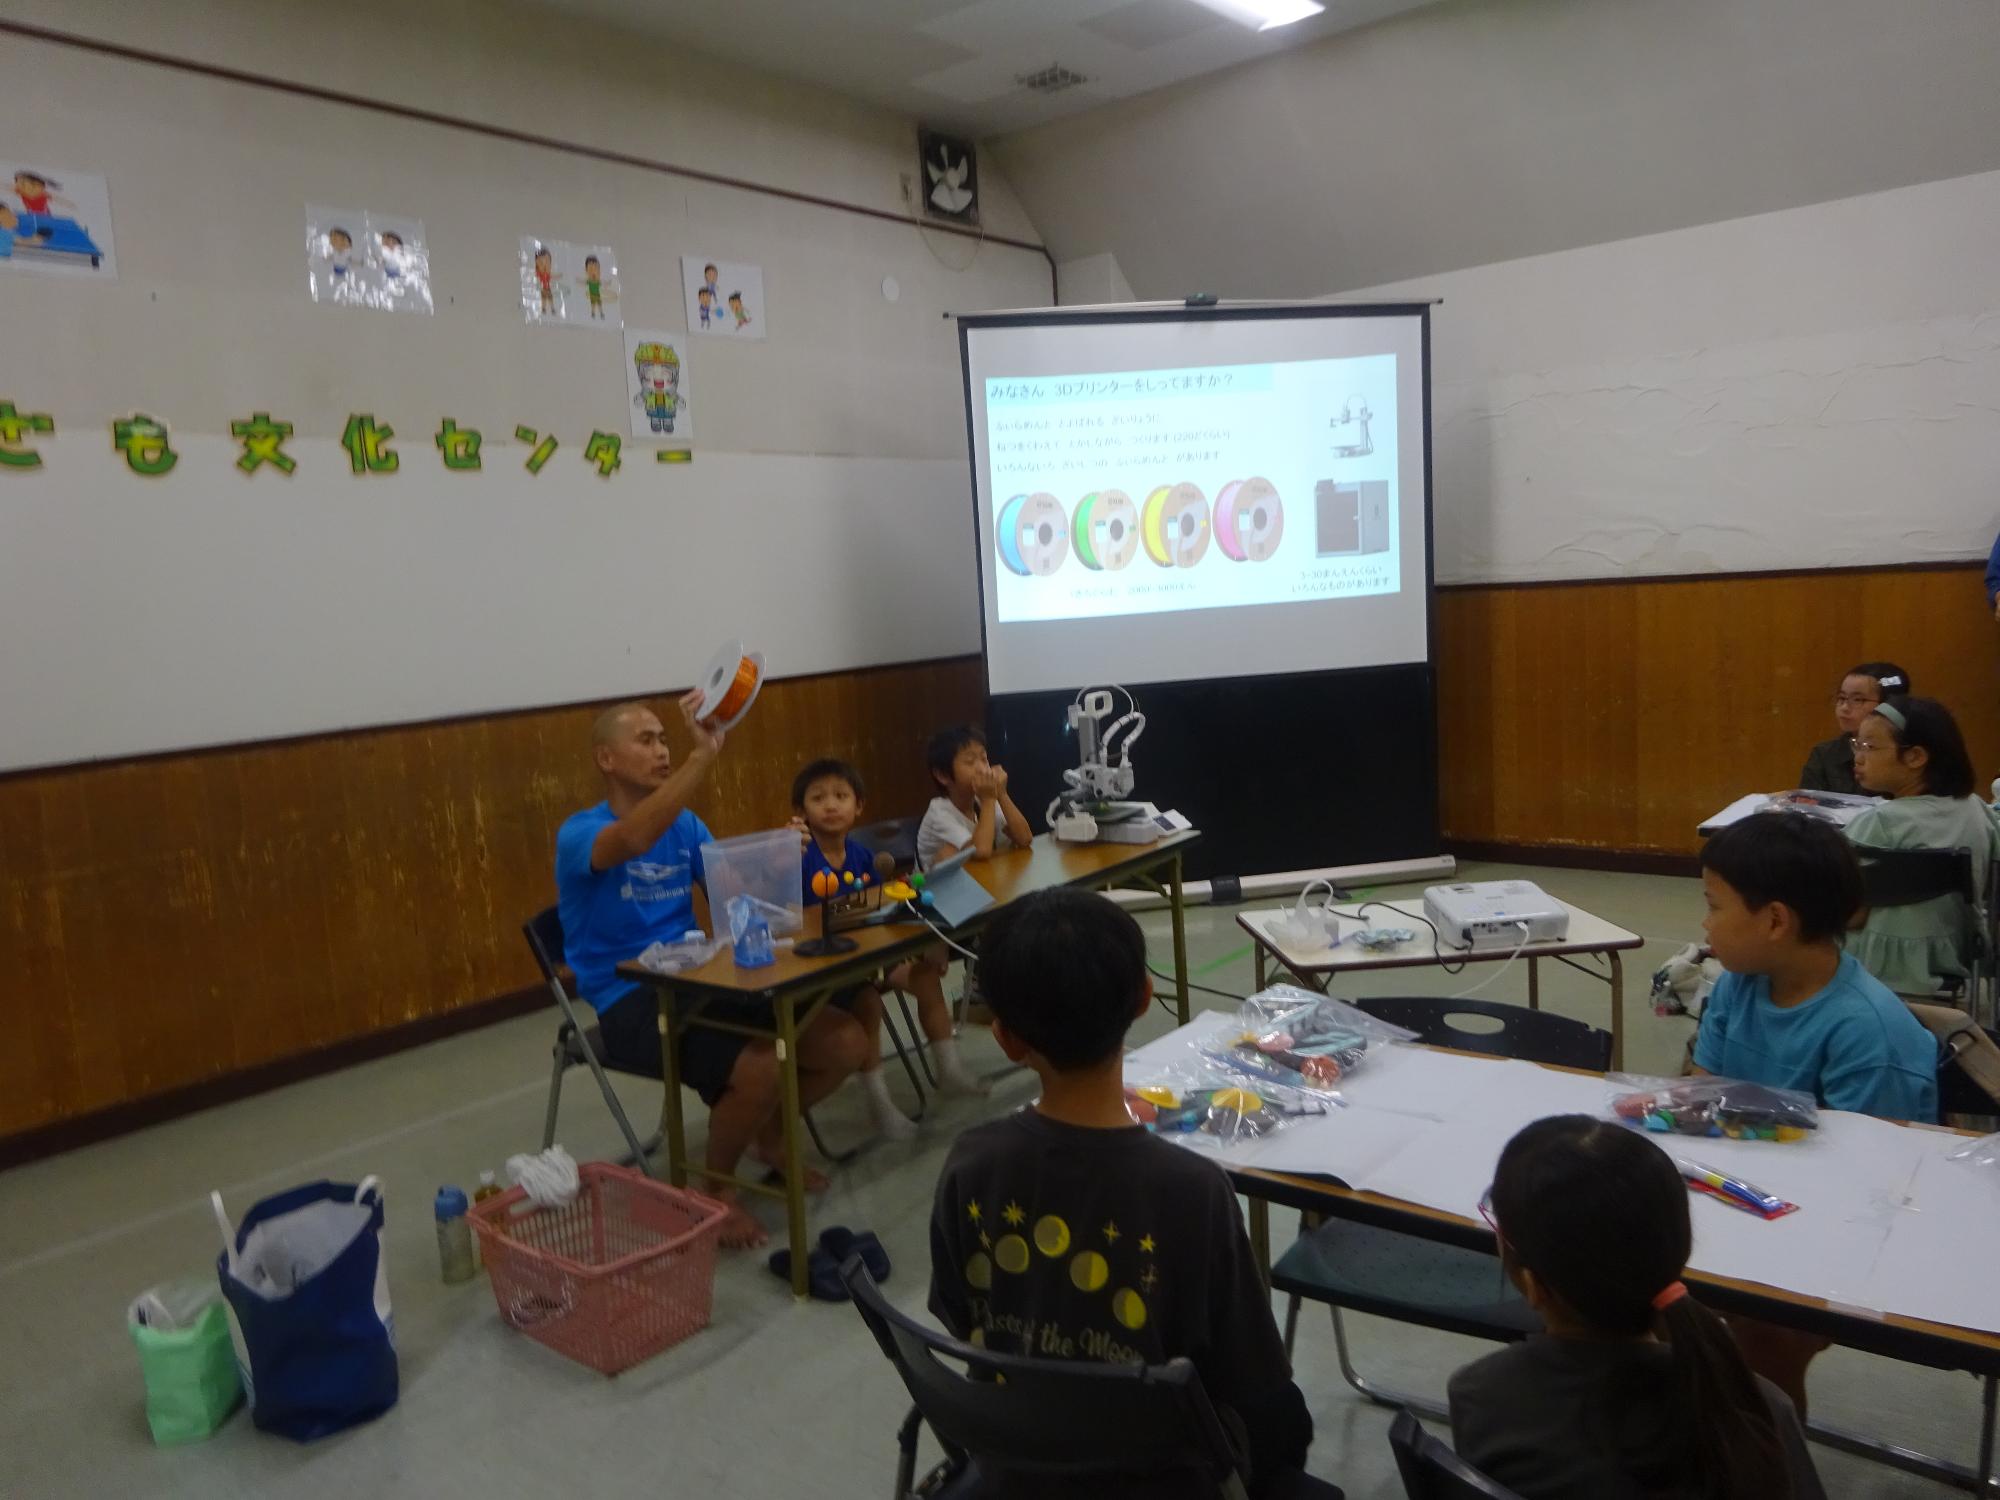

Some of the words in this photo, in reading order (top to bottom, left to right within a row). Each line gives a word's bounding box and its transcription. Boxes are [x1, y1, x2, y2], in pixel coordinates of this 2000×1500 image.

[991, 383, 1045, 399] みなさん
[1040, 1320, 1074, 1357] the
